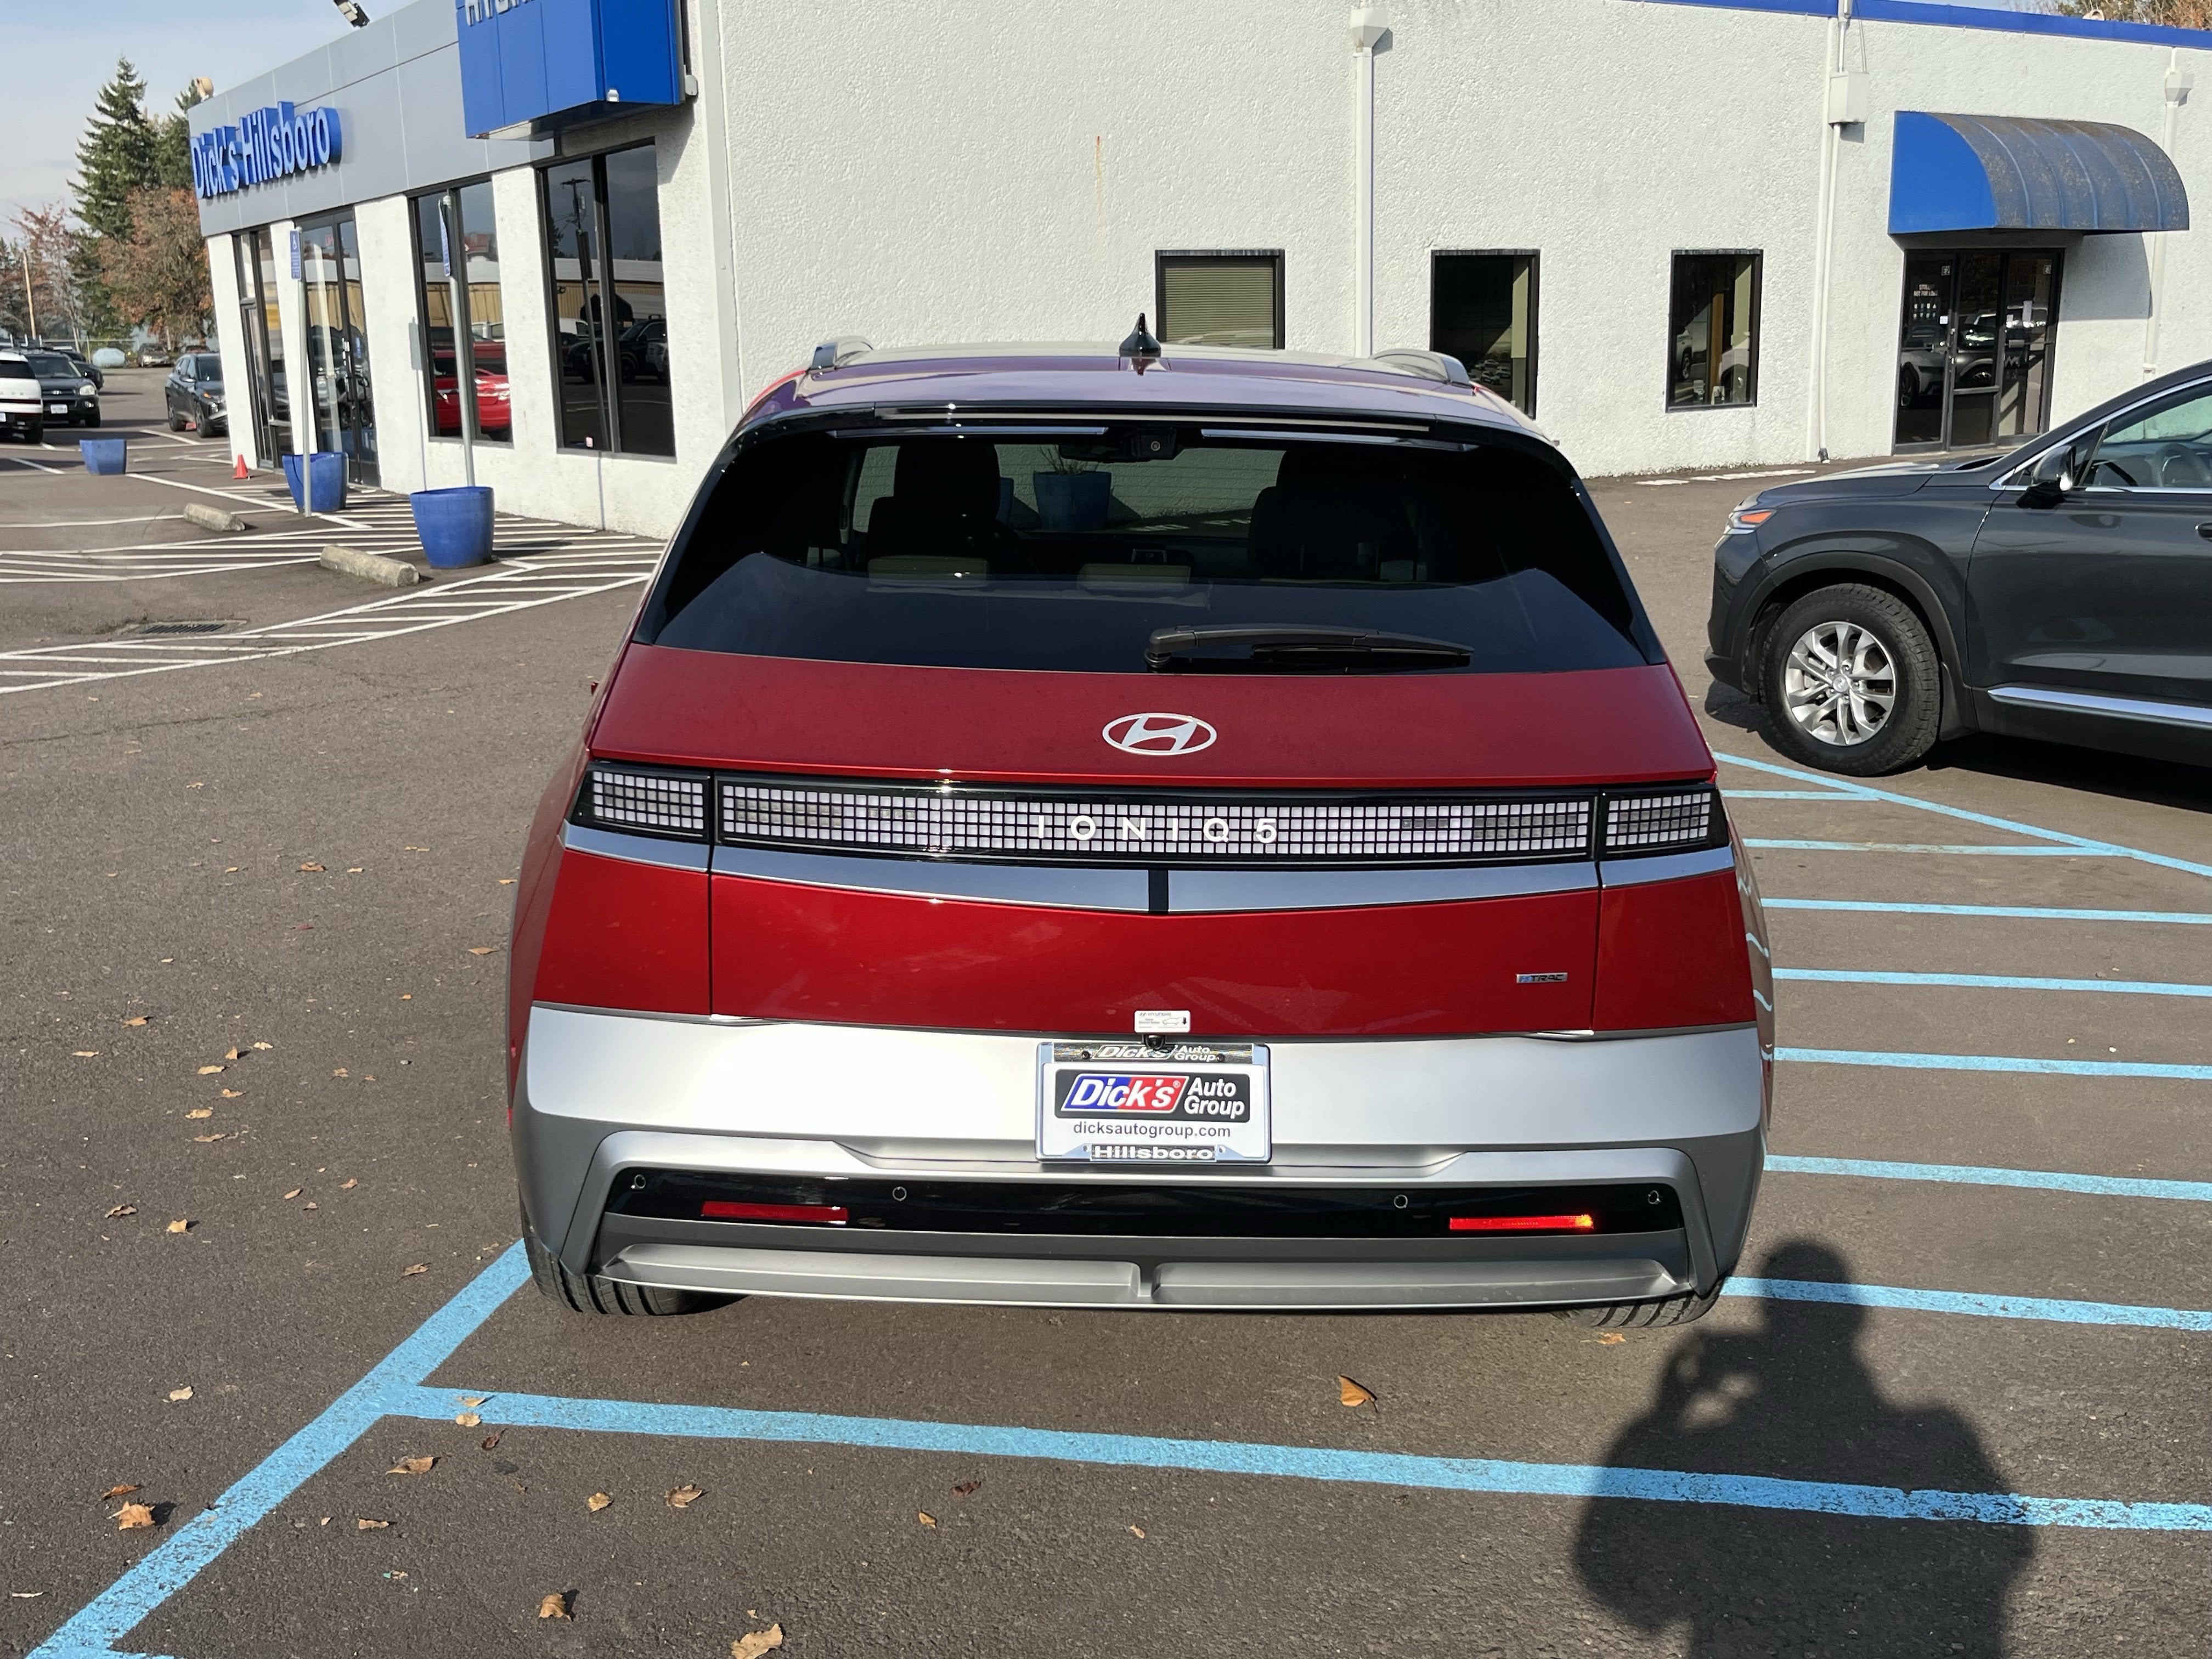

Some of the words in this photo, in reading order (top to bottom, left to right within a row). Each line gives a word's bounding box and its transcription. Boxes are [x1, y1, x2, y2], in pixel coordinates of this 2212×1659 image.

[190, 126, 239, 199] Dick's
[239, 101, 330, 185] Hillsboro
[1039, 815, 1229, 843] IONIQ
[1256, 818, 1277, 843] 5
[1174, 1052, 1216, 1062] Group
[1181, 1045, 1211, 1053] Auto
[1070, 1077, 1175, 1108] Dick's
[1187, 1077, 1237, 1097] Auto
[1184, 1095, 1245, 1119] Group
[1073, 1121, 1231, 1138] dicksautogroup.com
[1094, 1145, 1214, 1160] Hillsboro
